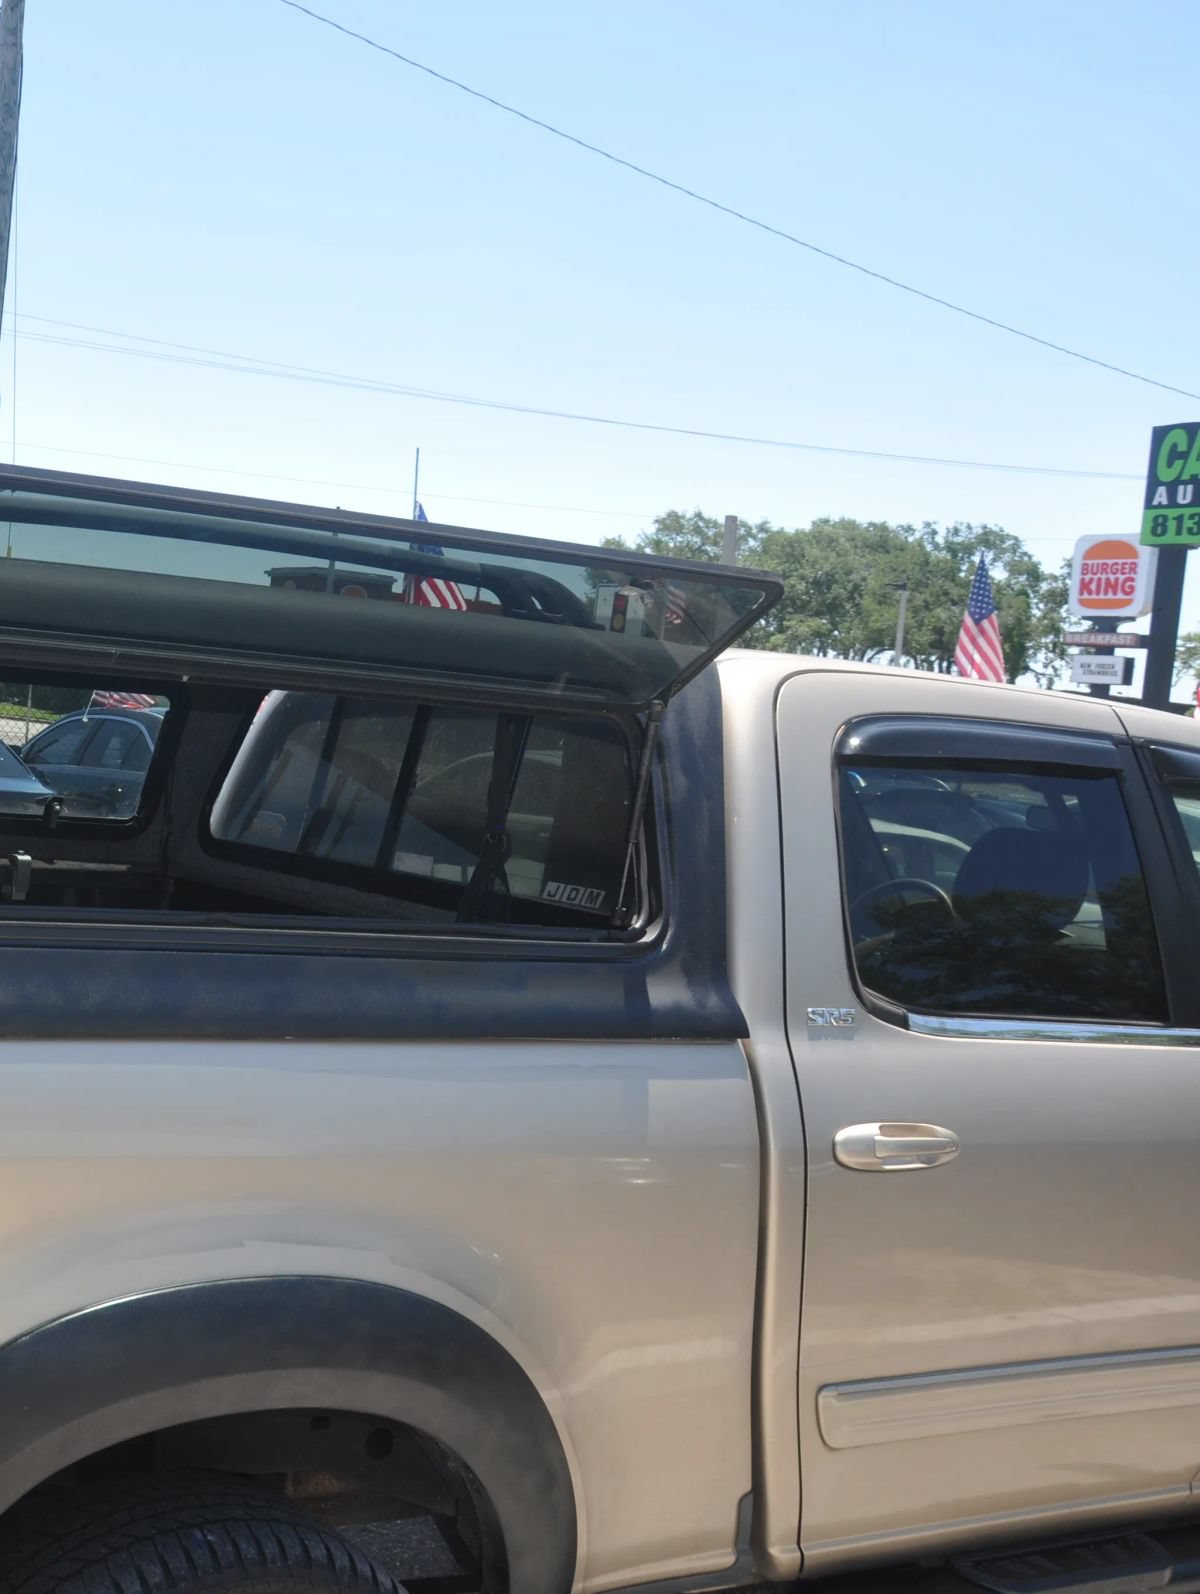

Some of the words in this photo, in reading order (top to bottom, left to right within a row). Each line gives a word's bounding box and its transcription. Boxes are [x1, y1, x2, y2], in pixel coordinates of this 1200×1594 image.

[1081, 561, 1138, 576] BURGER
[1079, 576, 1136, 597] KING
[1065, 633, 1133, 646] BREAKFAST
[544, 882, 604, 908] JDM
[807, 1008, 856, 1026] SR5
